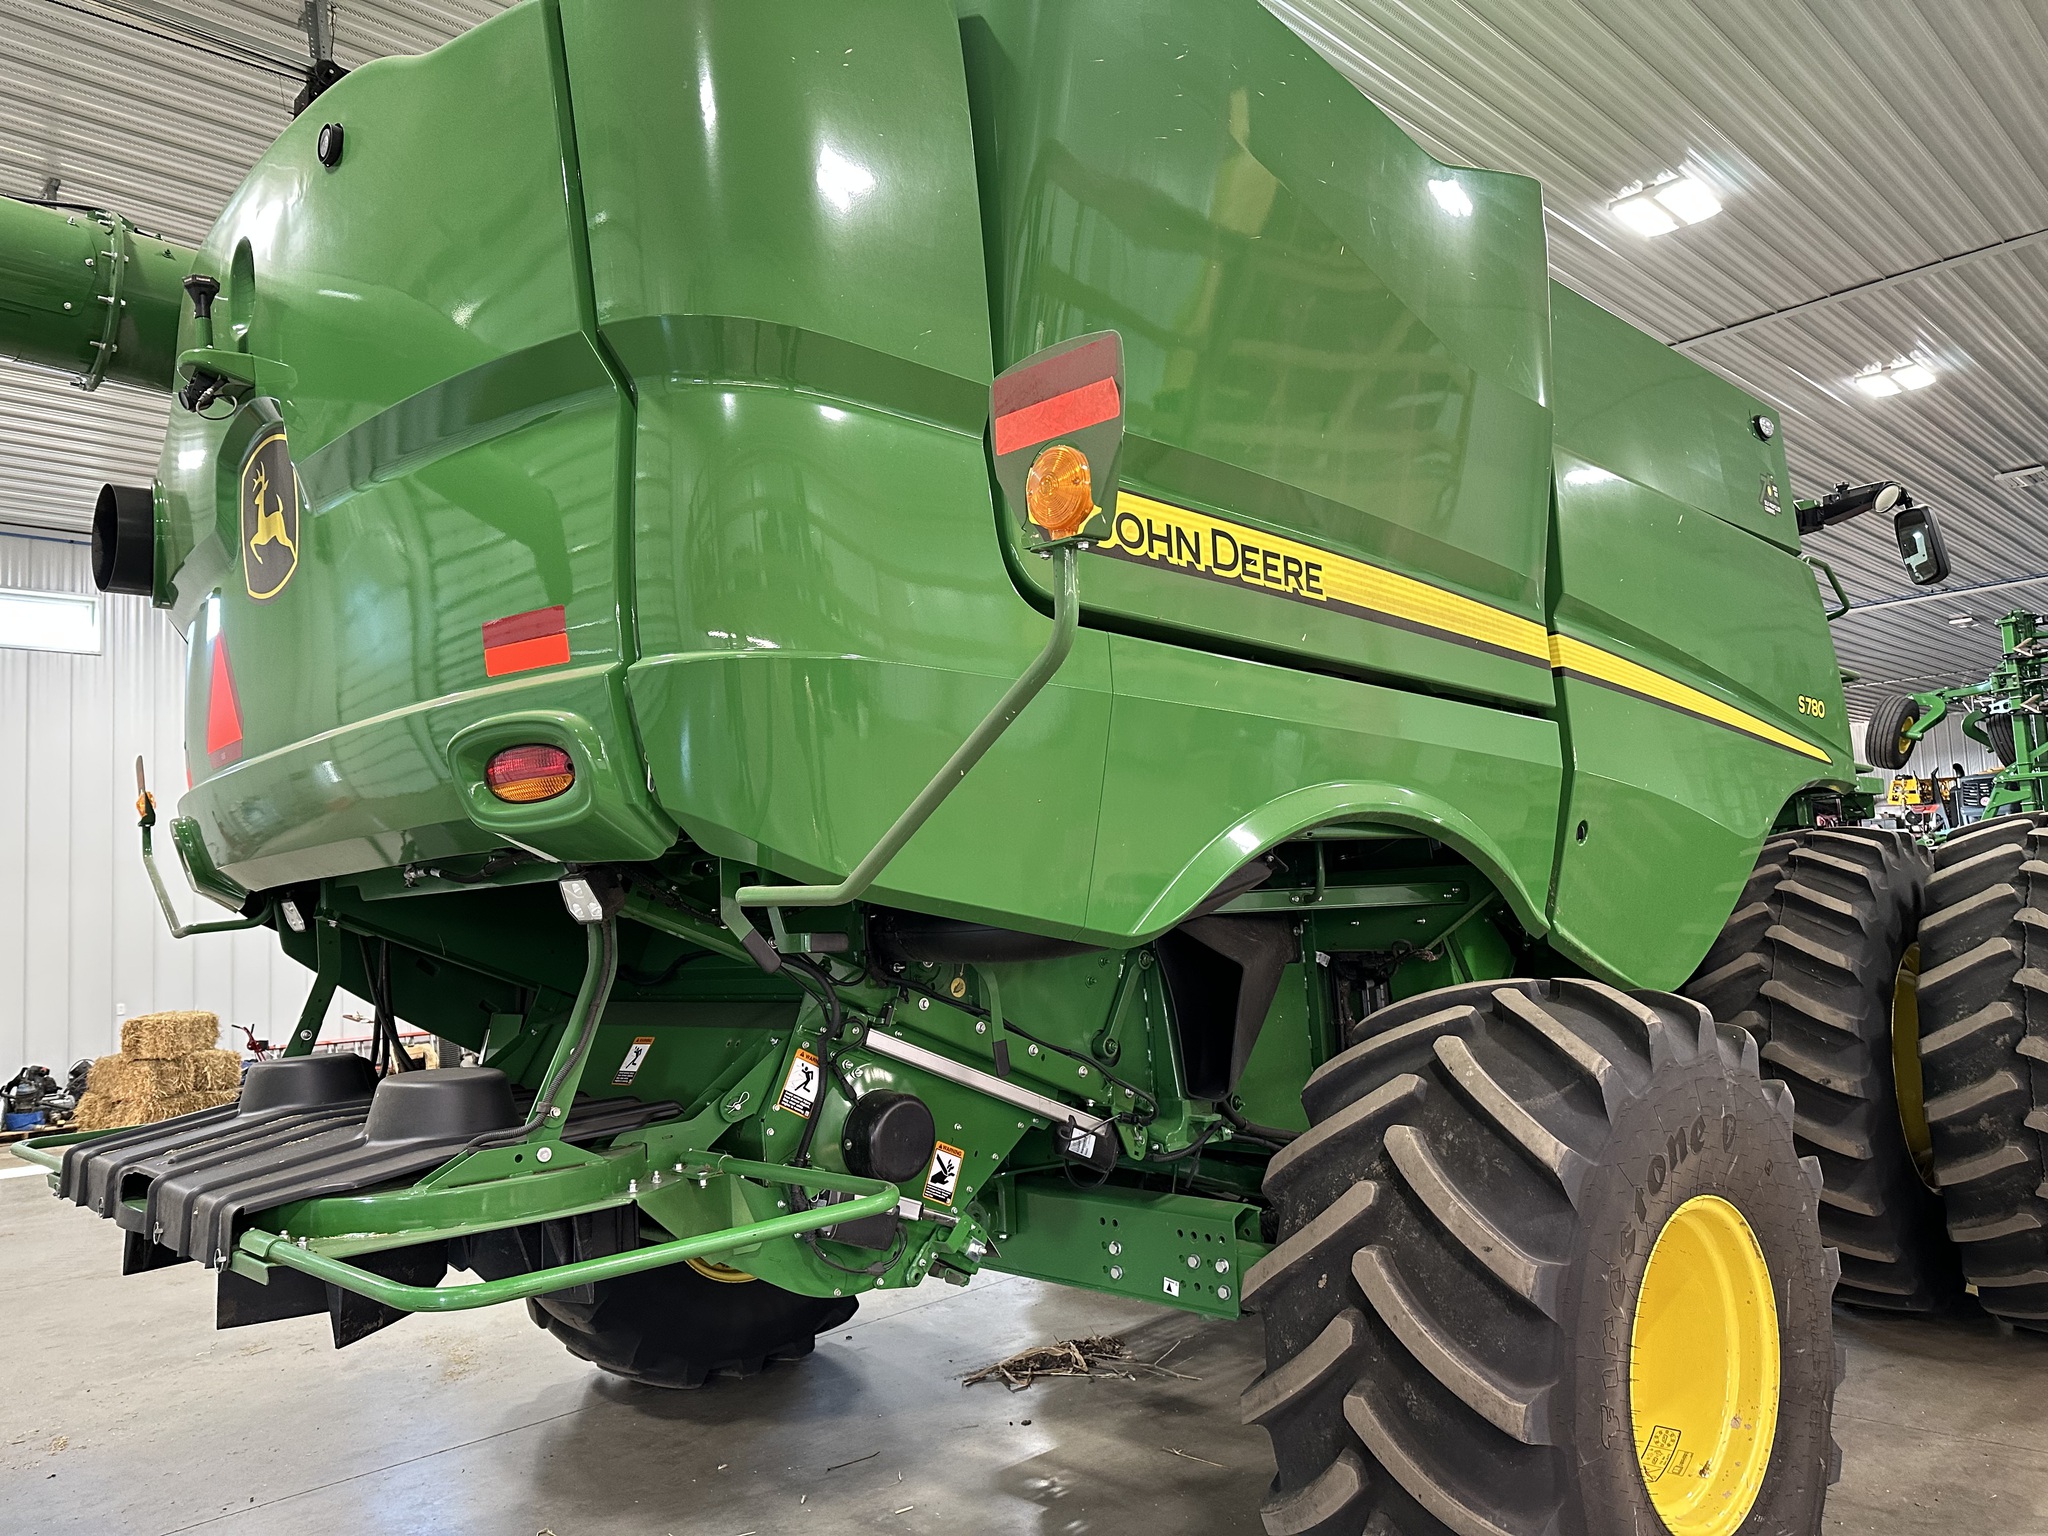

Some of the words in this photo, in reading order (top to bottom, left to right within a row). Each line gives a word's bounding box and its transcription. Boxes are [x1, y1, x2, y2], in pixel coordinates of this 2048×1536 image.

[1115, 512, 1200, 565] OHN
[1211, 527, 1324, 596] DEERE
[1798, 695, 1826, 718] S780
[942, 1146, 963, 1157] WARNING
